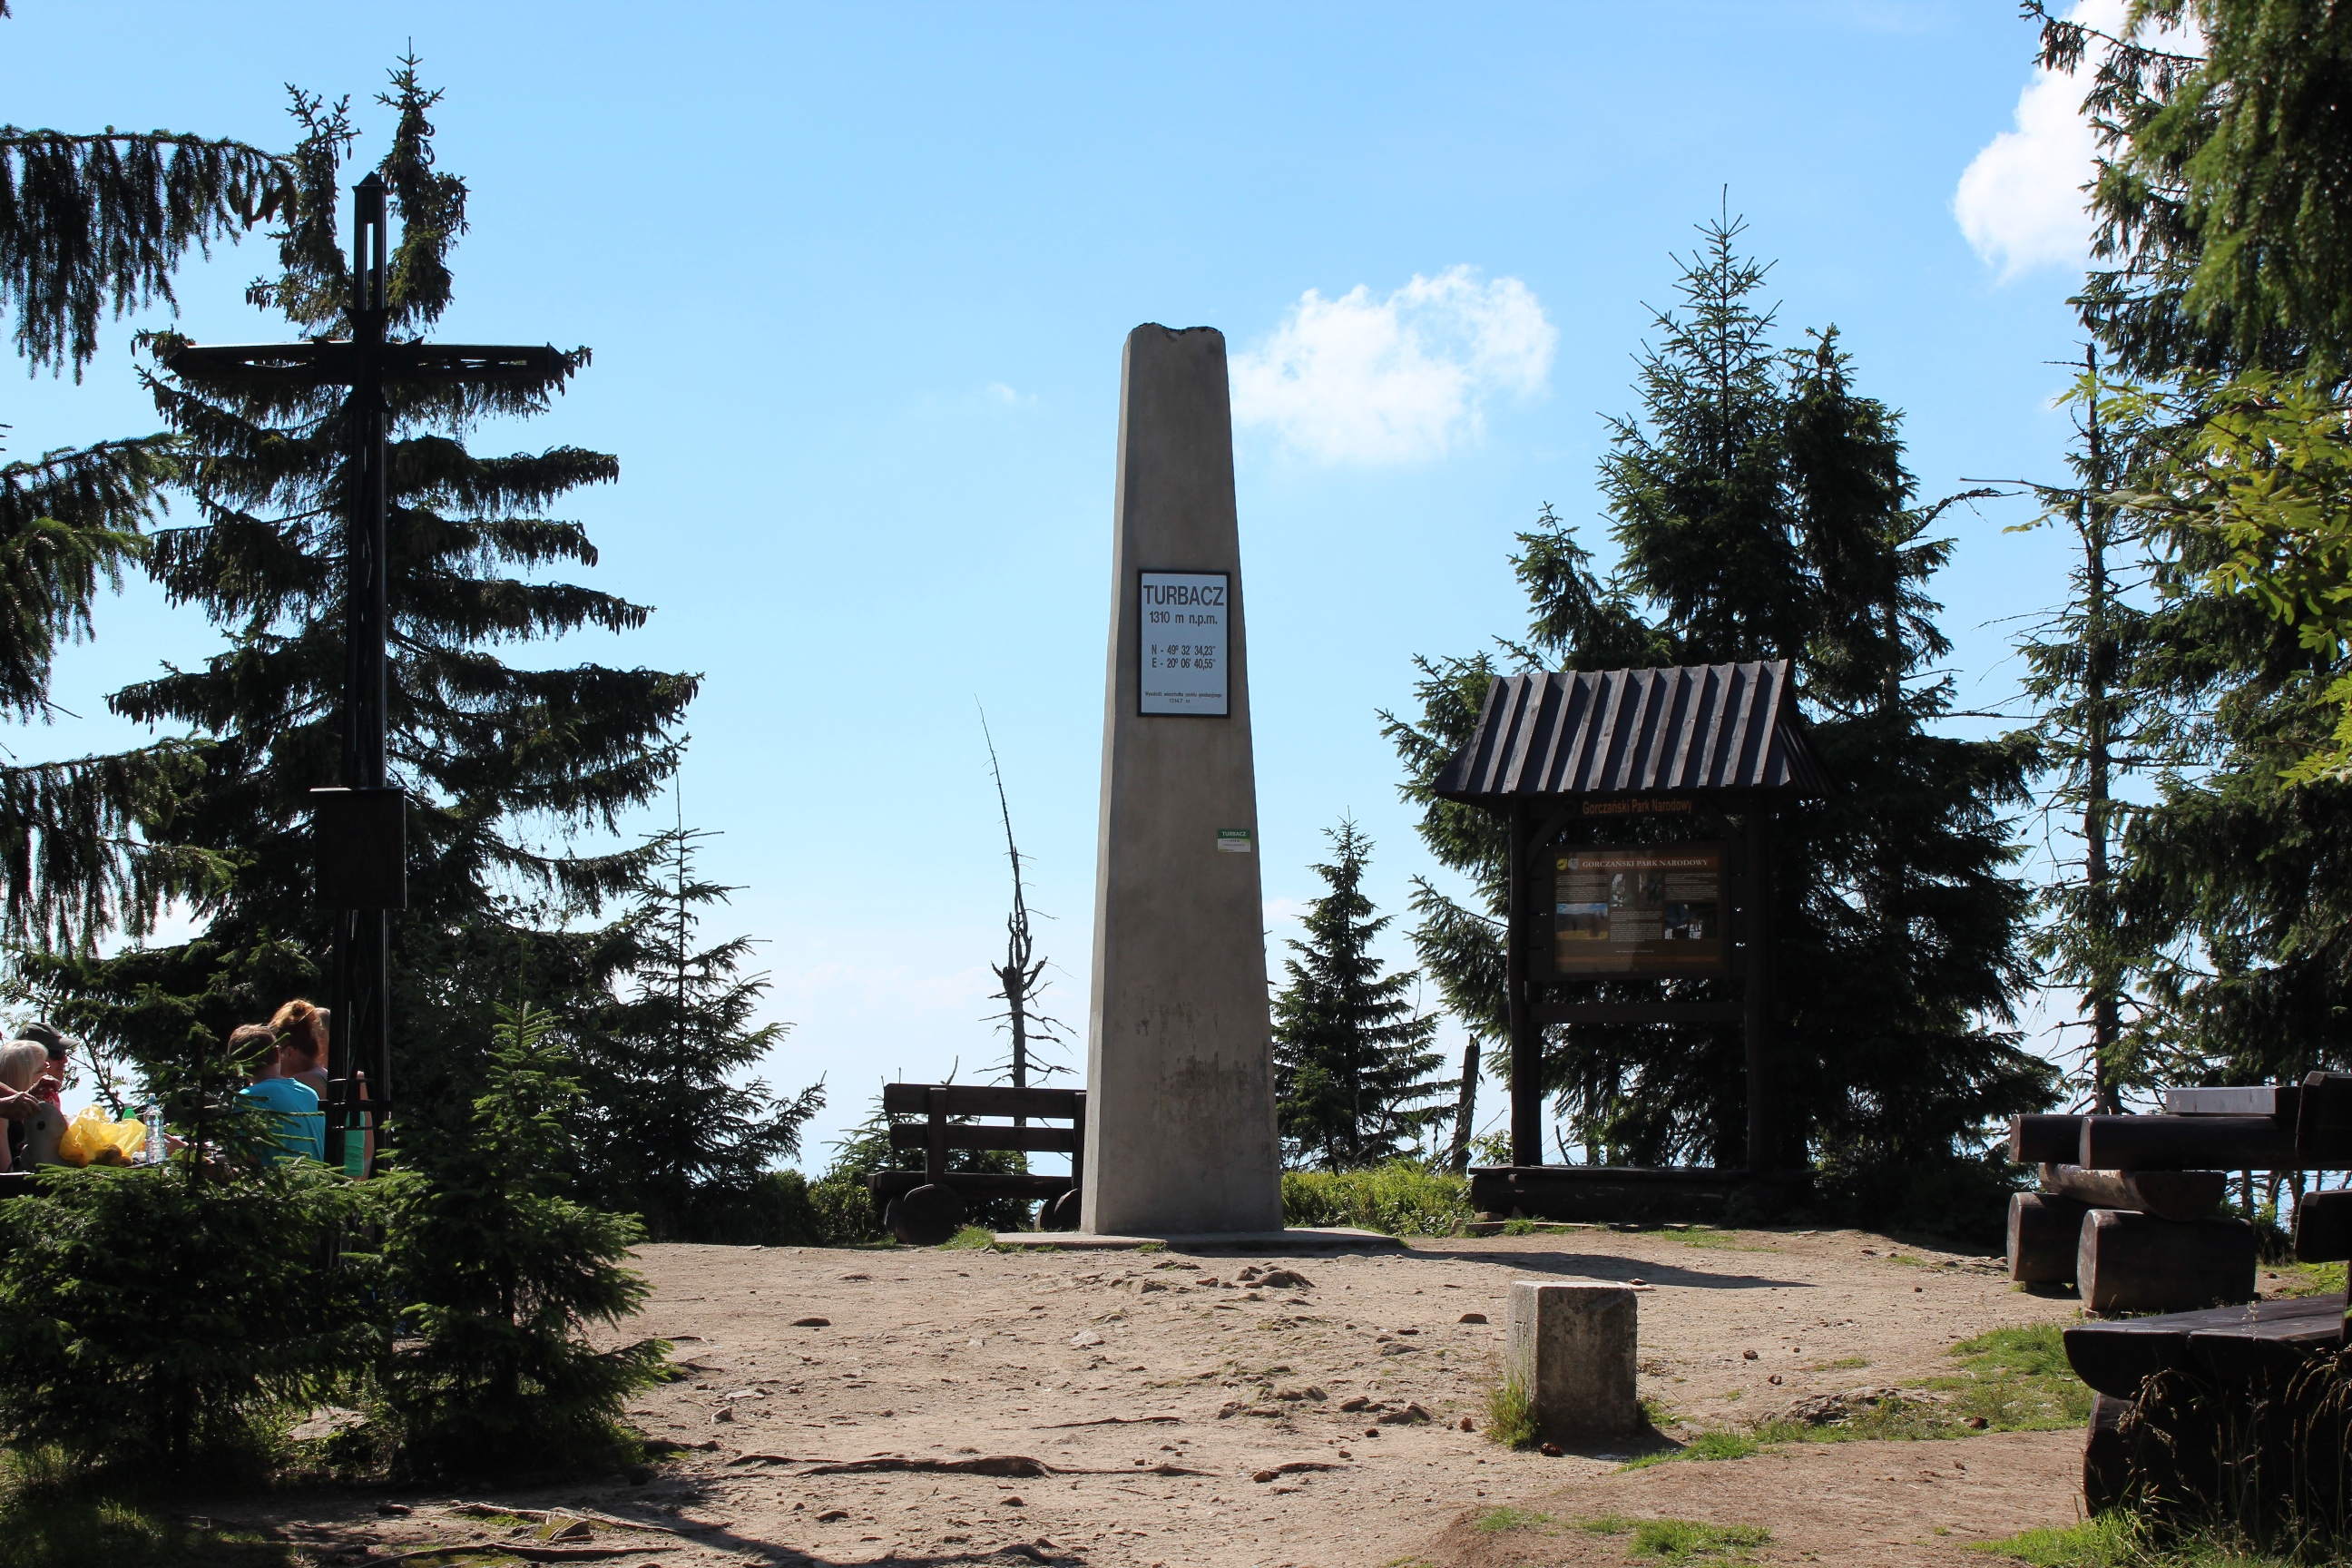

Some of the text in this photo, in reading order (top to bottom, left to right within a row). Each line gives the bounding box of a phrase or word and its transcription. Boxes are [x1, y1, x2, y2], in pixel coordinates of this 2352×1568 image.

[1143, 585, 1224, 606] TURBACZ
[1150, 611, 1218, 626] 1310 m n.p.m.
[1152, 644, 1157, 654] N
[1152, 658, 1157, 668] E
[1583, 799, 1692, 815] Gorczański Park Narodowy
[1582, 858, 1709, 868] GORCZAŃSKI PARK NARODOWY
